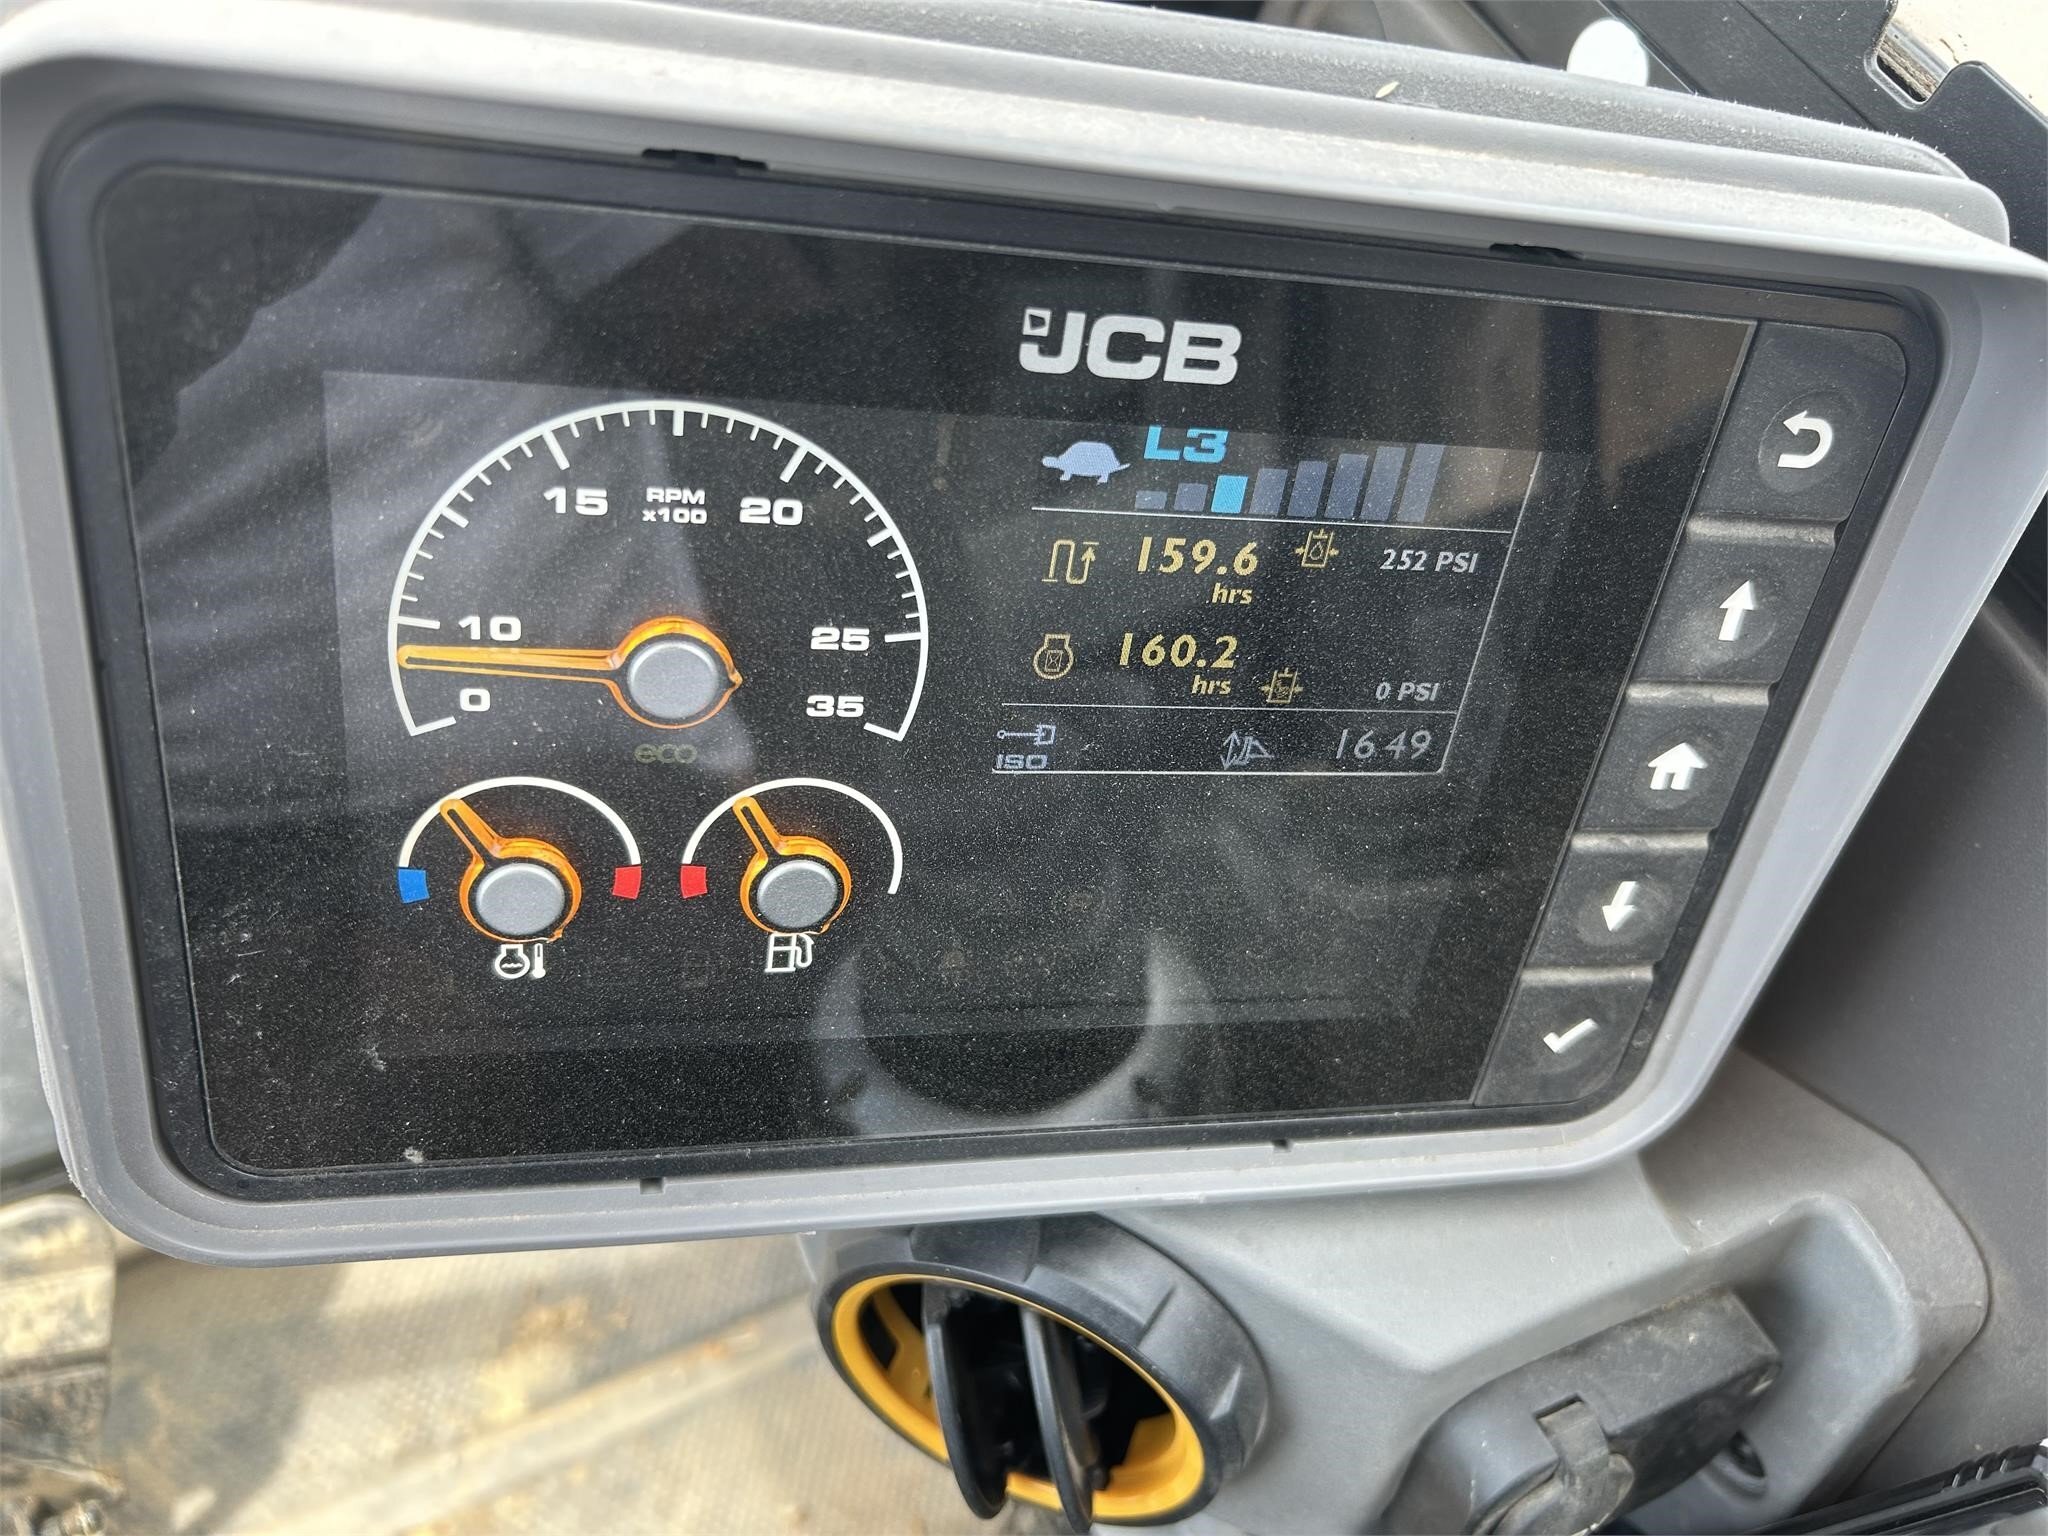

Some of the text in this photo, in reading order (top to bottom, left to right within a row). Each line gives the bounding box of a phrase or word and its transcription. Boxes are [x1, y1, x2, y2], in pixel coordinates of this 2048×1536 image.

[1018, 306, 1243, 386] JCB
[1143, 425, 1230, 463] L3
[542, 486, 609, 517] 15
[645, 487, 706, 504] RPM
[641, 508, 708, 525] x100
[739, 498, 804, 526] 20
[1135, 536, 1259, 576] 159.6
[1379, 548, 1479, 575] 252 PSI
[1211, 583, 1254, 606] hrs
[457, 615, 522, 642] 10
[810, 627, 871, 652] 25
[1118, 632, 1239, 670] 160.2
[1191, 675, 1232, 696] hrs
[1375, 682, 1440, 703] 0 PSI
[458, 687, 492, 713] 0
[805, 695, 865, 720] 35
[634, 743, 698, 764] eco
[996, 753, 1049, 770] ISO
